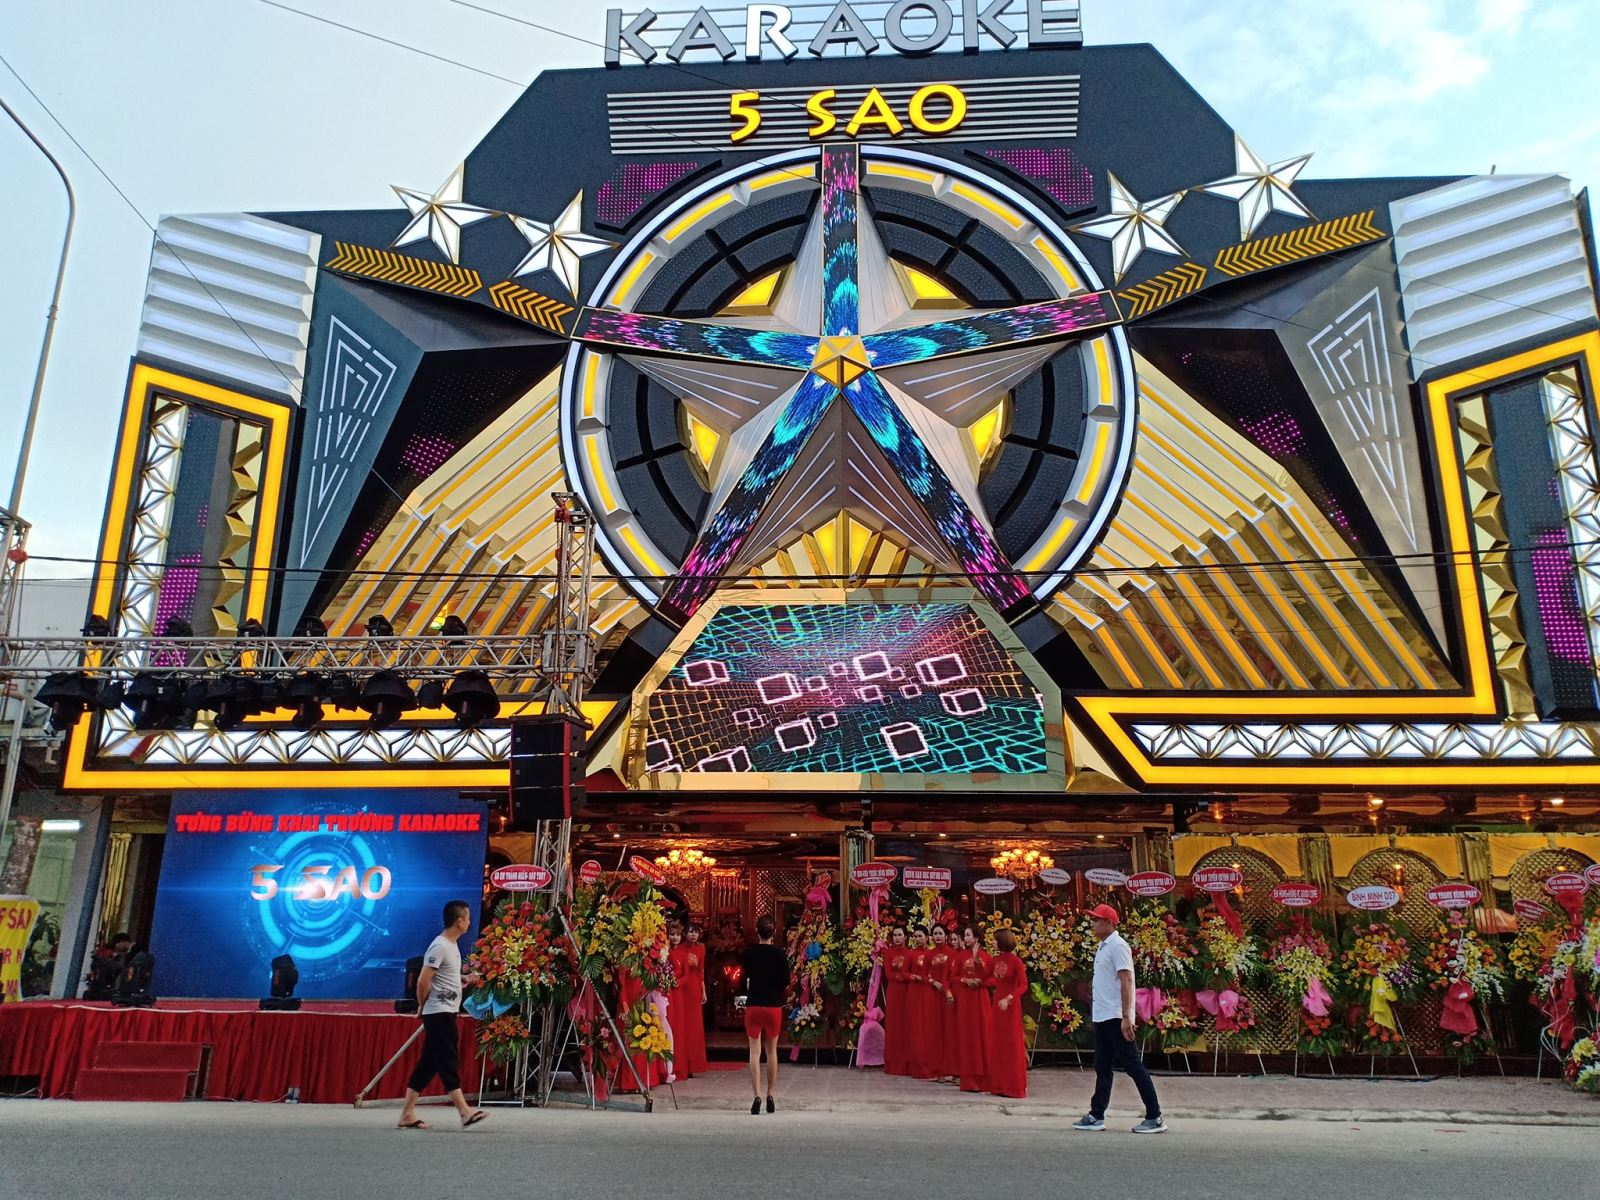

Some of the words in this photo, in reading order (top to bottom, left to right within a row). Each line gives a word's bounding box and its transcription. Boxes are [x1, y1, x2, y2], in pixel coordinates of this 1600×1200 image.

[604, 0, 1083, 68] KARAOKE
[729, 90, 762, 144] 5
[806, 83, 968, 141] SAO
[277, 814, 320, 832] KHAI
[399, 813, 481, 832] KARAOKE
[250, 864, 284, 900] 5
[294, 865, 392, 900] SAO
[1367, 892, 1383, 901] MINH
